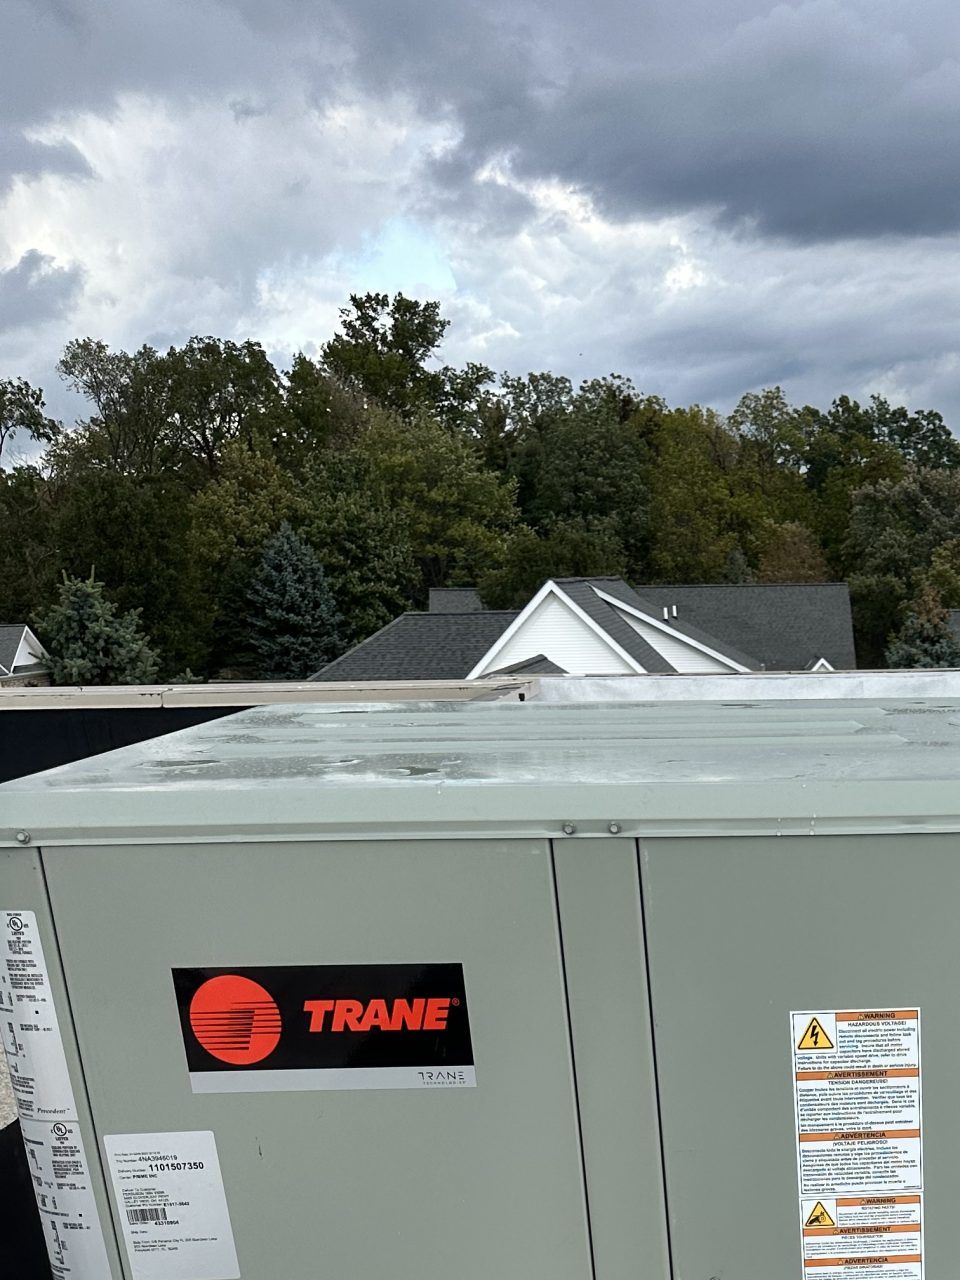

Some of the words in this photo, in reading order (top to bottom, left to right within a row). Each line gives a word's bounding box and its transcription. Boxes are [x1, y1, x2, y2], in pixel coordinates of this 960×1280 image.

[303, 998, 450, 1032] TRANE
[864, 1012, 896, 1020] WARNING
[417, 1071, 465, 1082] TRANE
[833, 1070, 888, 1078] AVERTISSEMENT
[148, 1161, 204, 1172] 1101507350
[839, 1226, 891, 1234] AVERTISSEMENT
